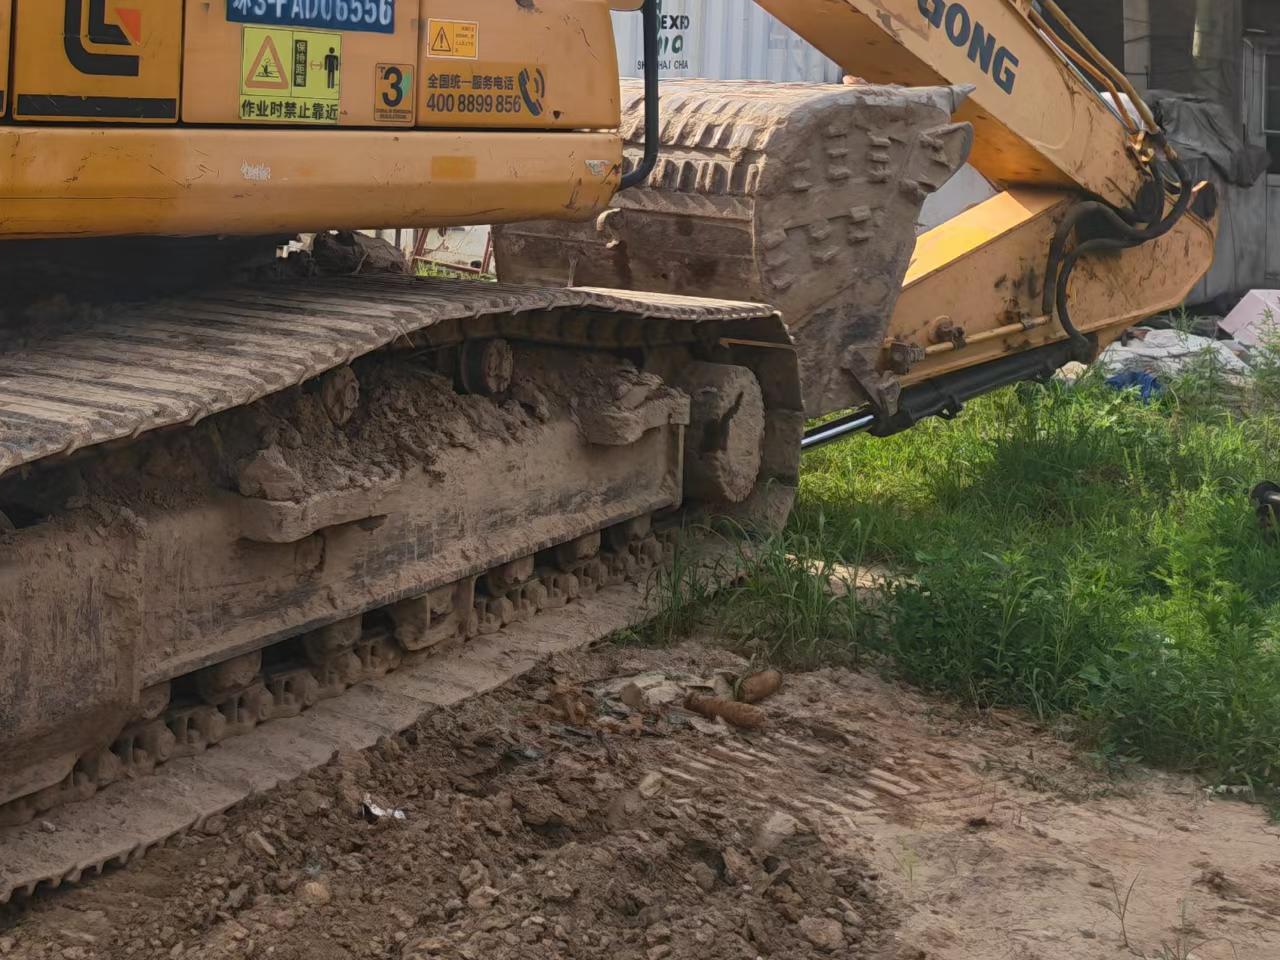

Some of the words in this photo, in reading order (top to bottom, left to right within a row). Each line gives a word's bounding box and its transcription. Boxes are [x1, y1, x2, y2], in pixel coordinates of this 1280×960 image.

[382, 66, 403, 107] 3
[428, 73, 514, 91] 全国统一服务电话
[241, 99, 338, 121] 作业时禁止靠近
[426, 93, 455, 112] 400
[457, 94, 493, 113] 8899
[495, 95, 521, 113] 856
